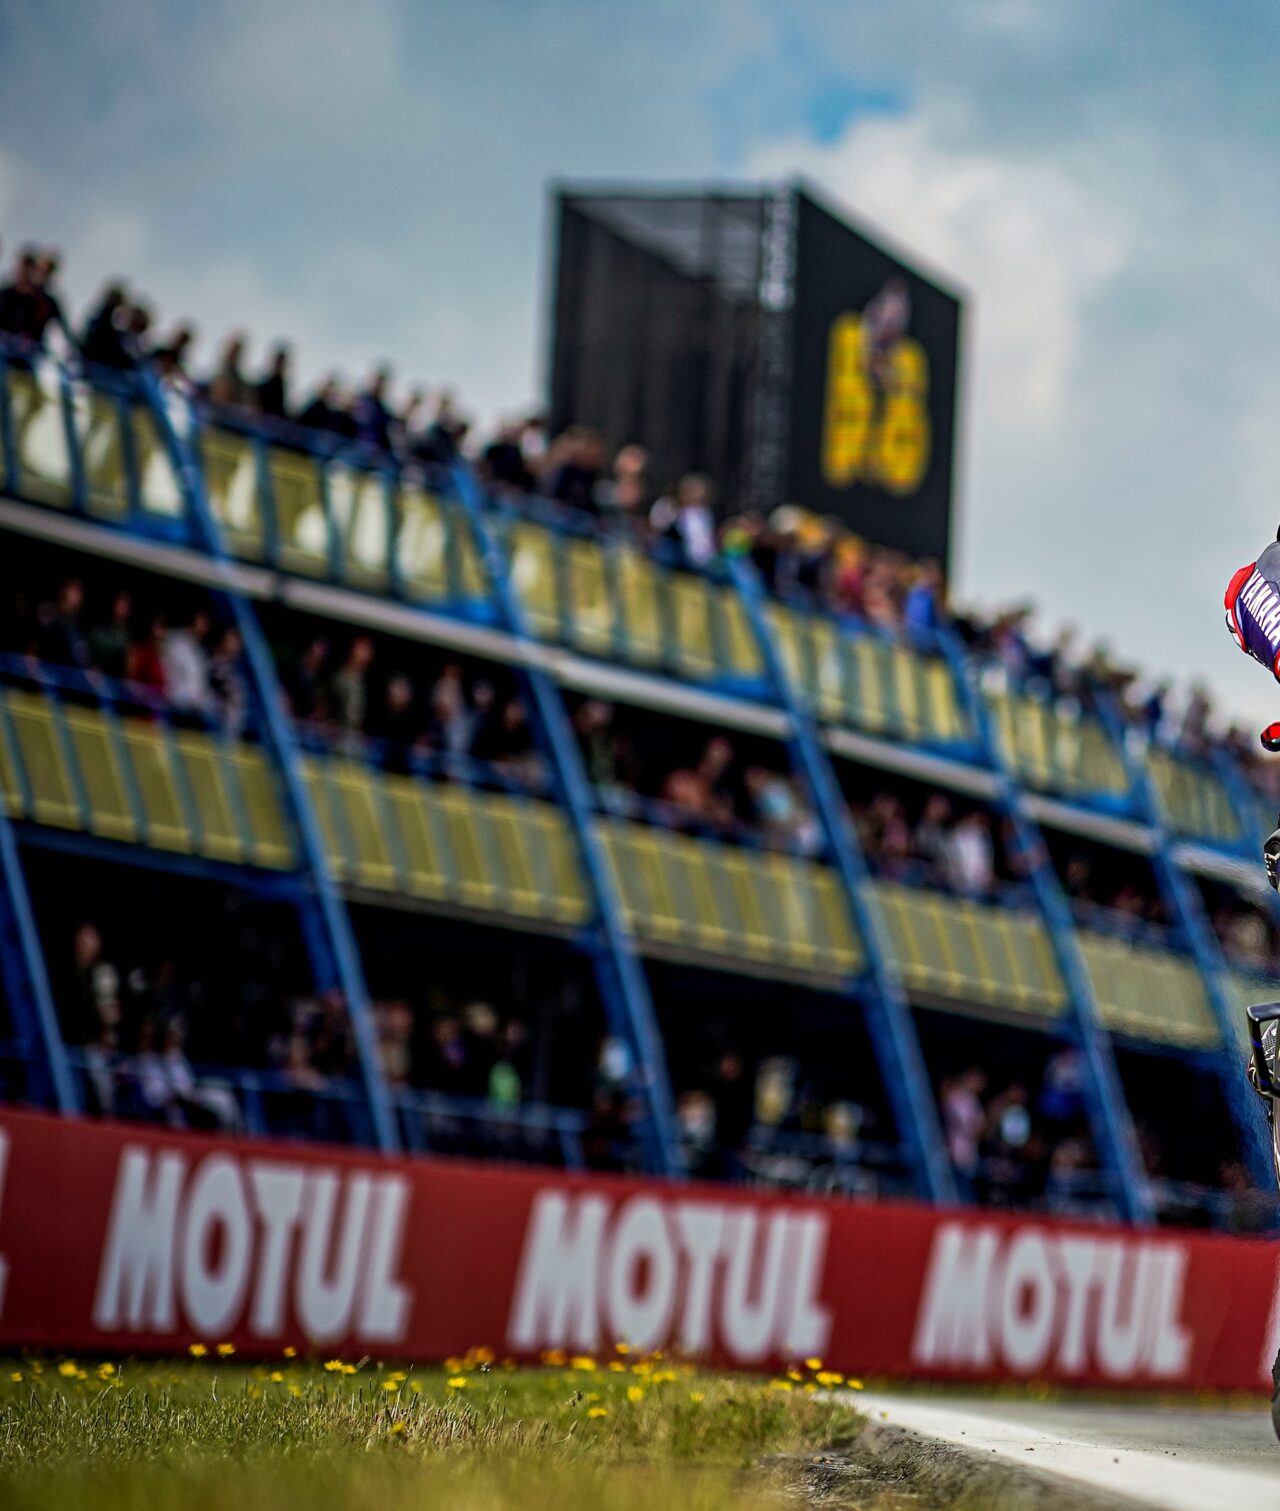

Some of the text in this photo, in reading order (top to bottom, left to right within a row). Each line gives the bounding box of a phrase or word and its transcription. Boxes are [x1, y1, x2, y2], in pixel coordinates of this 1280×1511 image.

[94, 1143, 411, 1340] MOTUL
[508, 1188, 832, 1361] MOTUL
[911, 1221, 1193, 1380] MOTUL
